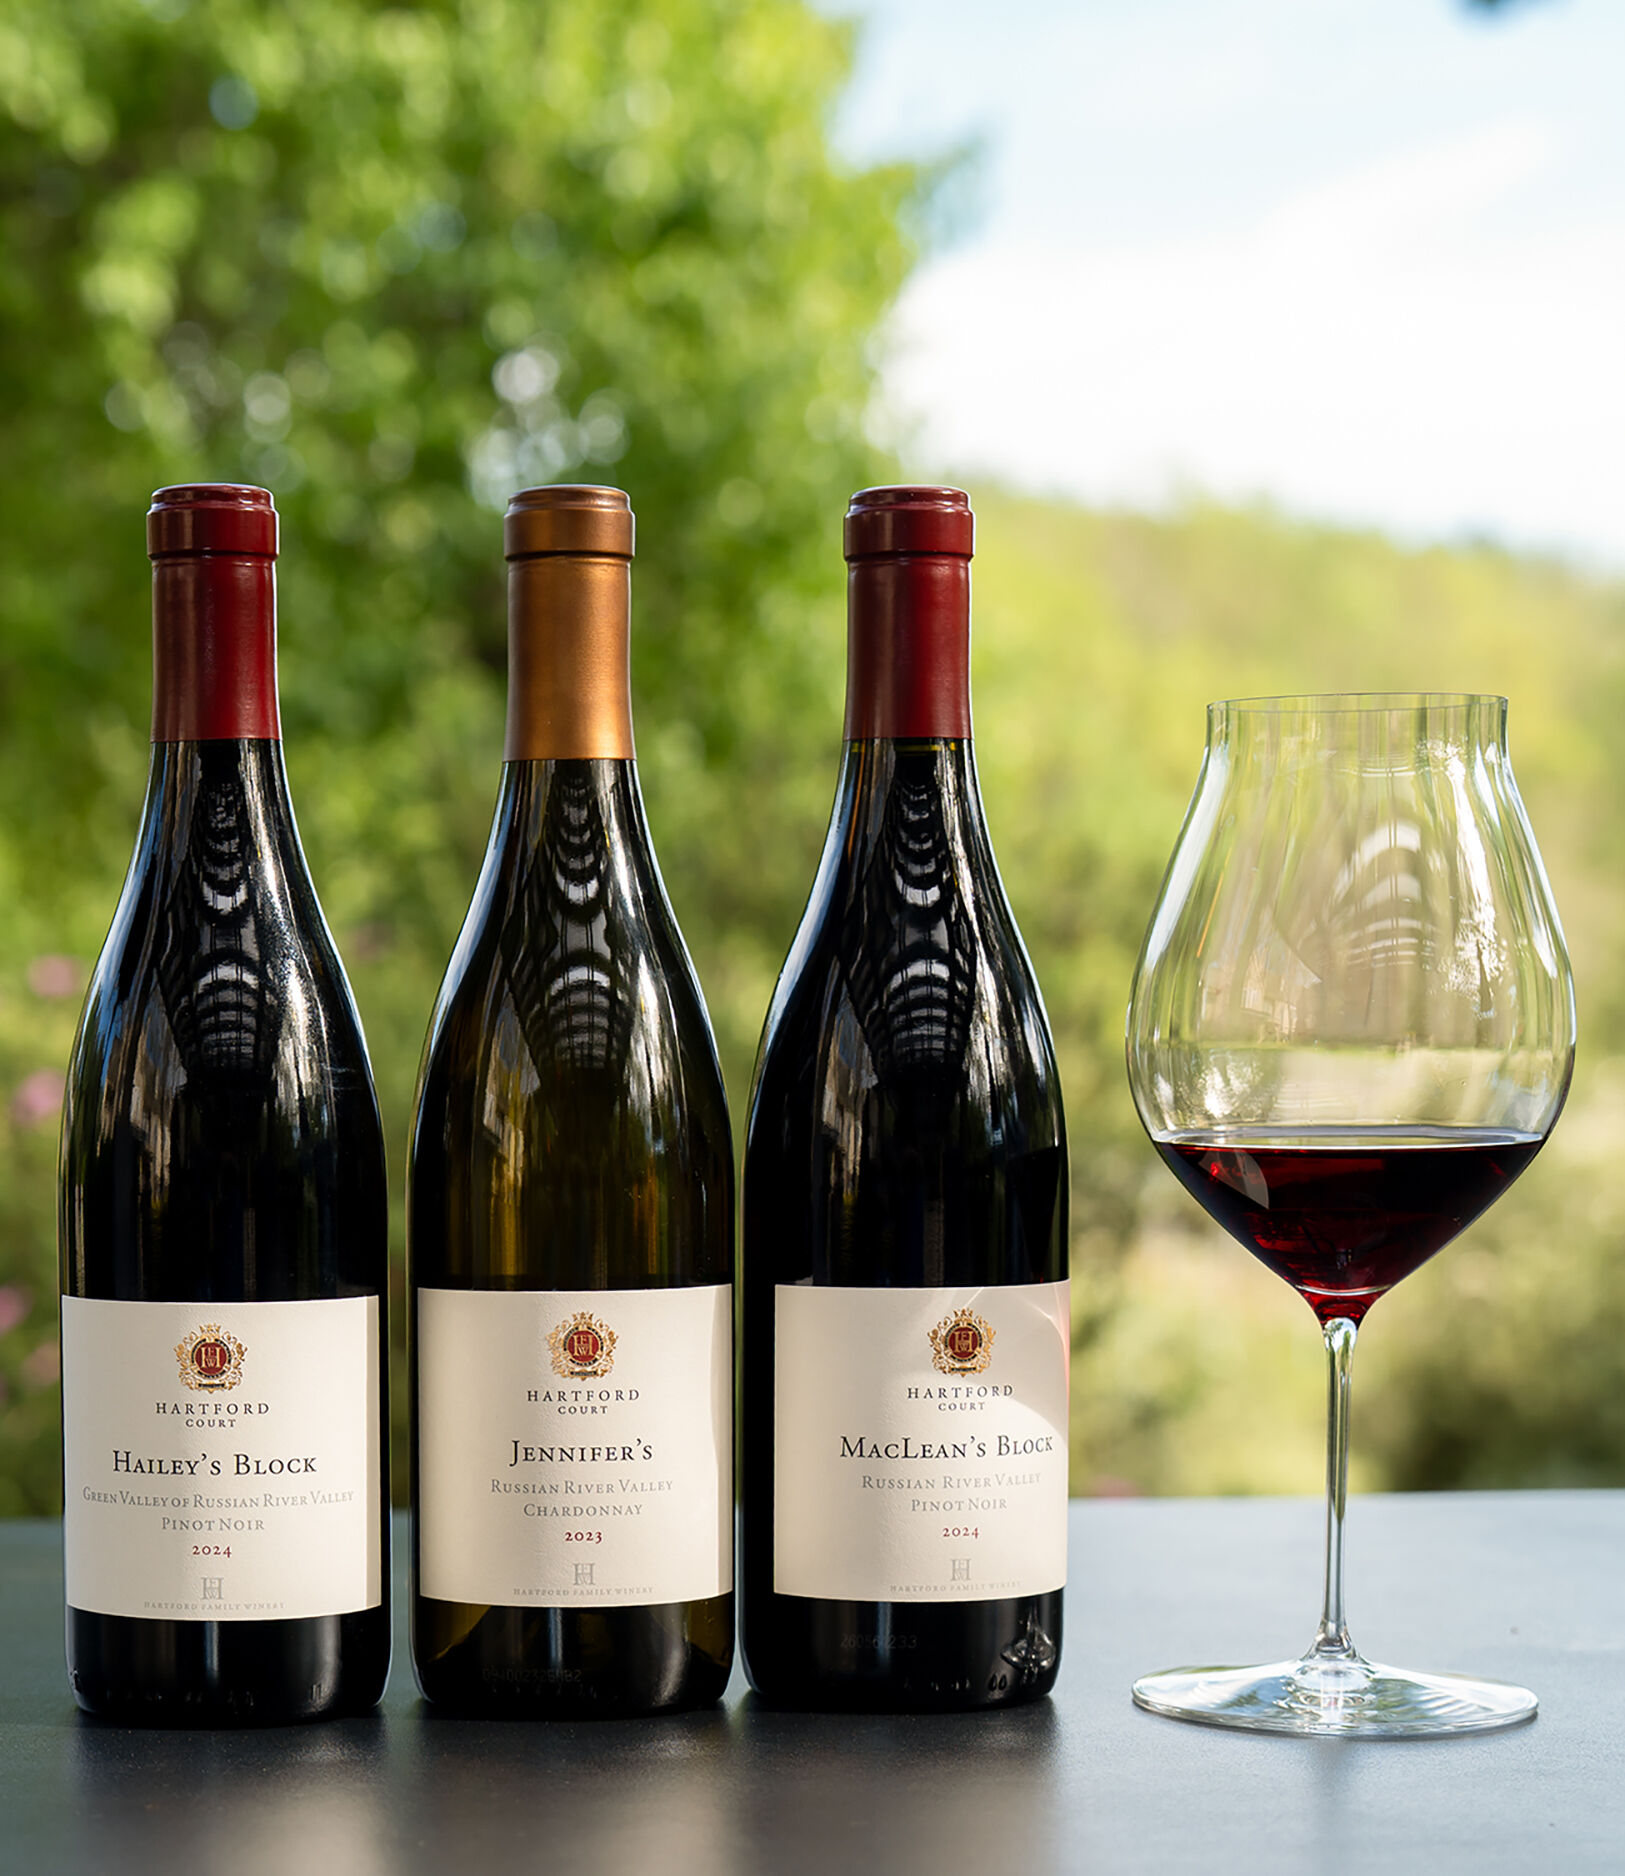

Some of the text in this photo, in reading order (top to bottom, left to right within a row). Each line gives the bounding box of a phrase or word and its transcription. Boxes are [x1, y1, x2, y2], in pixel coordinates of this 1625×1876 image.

[526, 1389, 640, 1402] HARTFORD
[907, 1385, 1013, 1399] HARTFORD
[155, 1403, 270, 1416] HARTFORD
[557, 1406, 609, 1415] COURT
[937, 1402, 986, 1411] COURT
[185, 1419, 237, 1428] COURT
[996, 1435, 1053, 1456] BLOCK
[232, 1454, 317, 1475] BLOCK
[491, 1479, 673, 1495] RUSSIAN RIVER VALLEY
[861, 1473, 1041, 1489] RUSSIAN RIVER VALLEY
[82, 1486, 354, 1508] GREEN VALLEY OF RUSSIAN RIVER VALLEY
[523, 1503, 643, 1517] CHARDONNAY
[911, 1498, 1008, 1511] PINOT NOIR
[161, 1517, 265, 1531] PINOT NOIR
[564, 1532, 603, 1544] 2023
[942, 1527, 979, 1539] 2024
[192, 1546, 233, 1558] 2024
